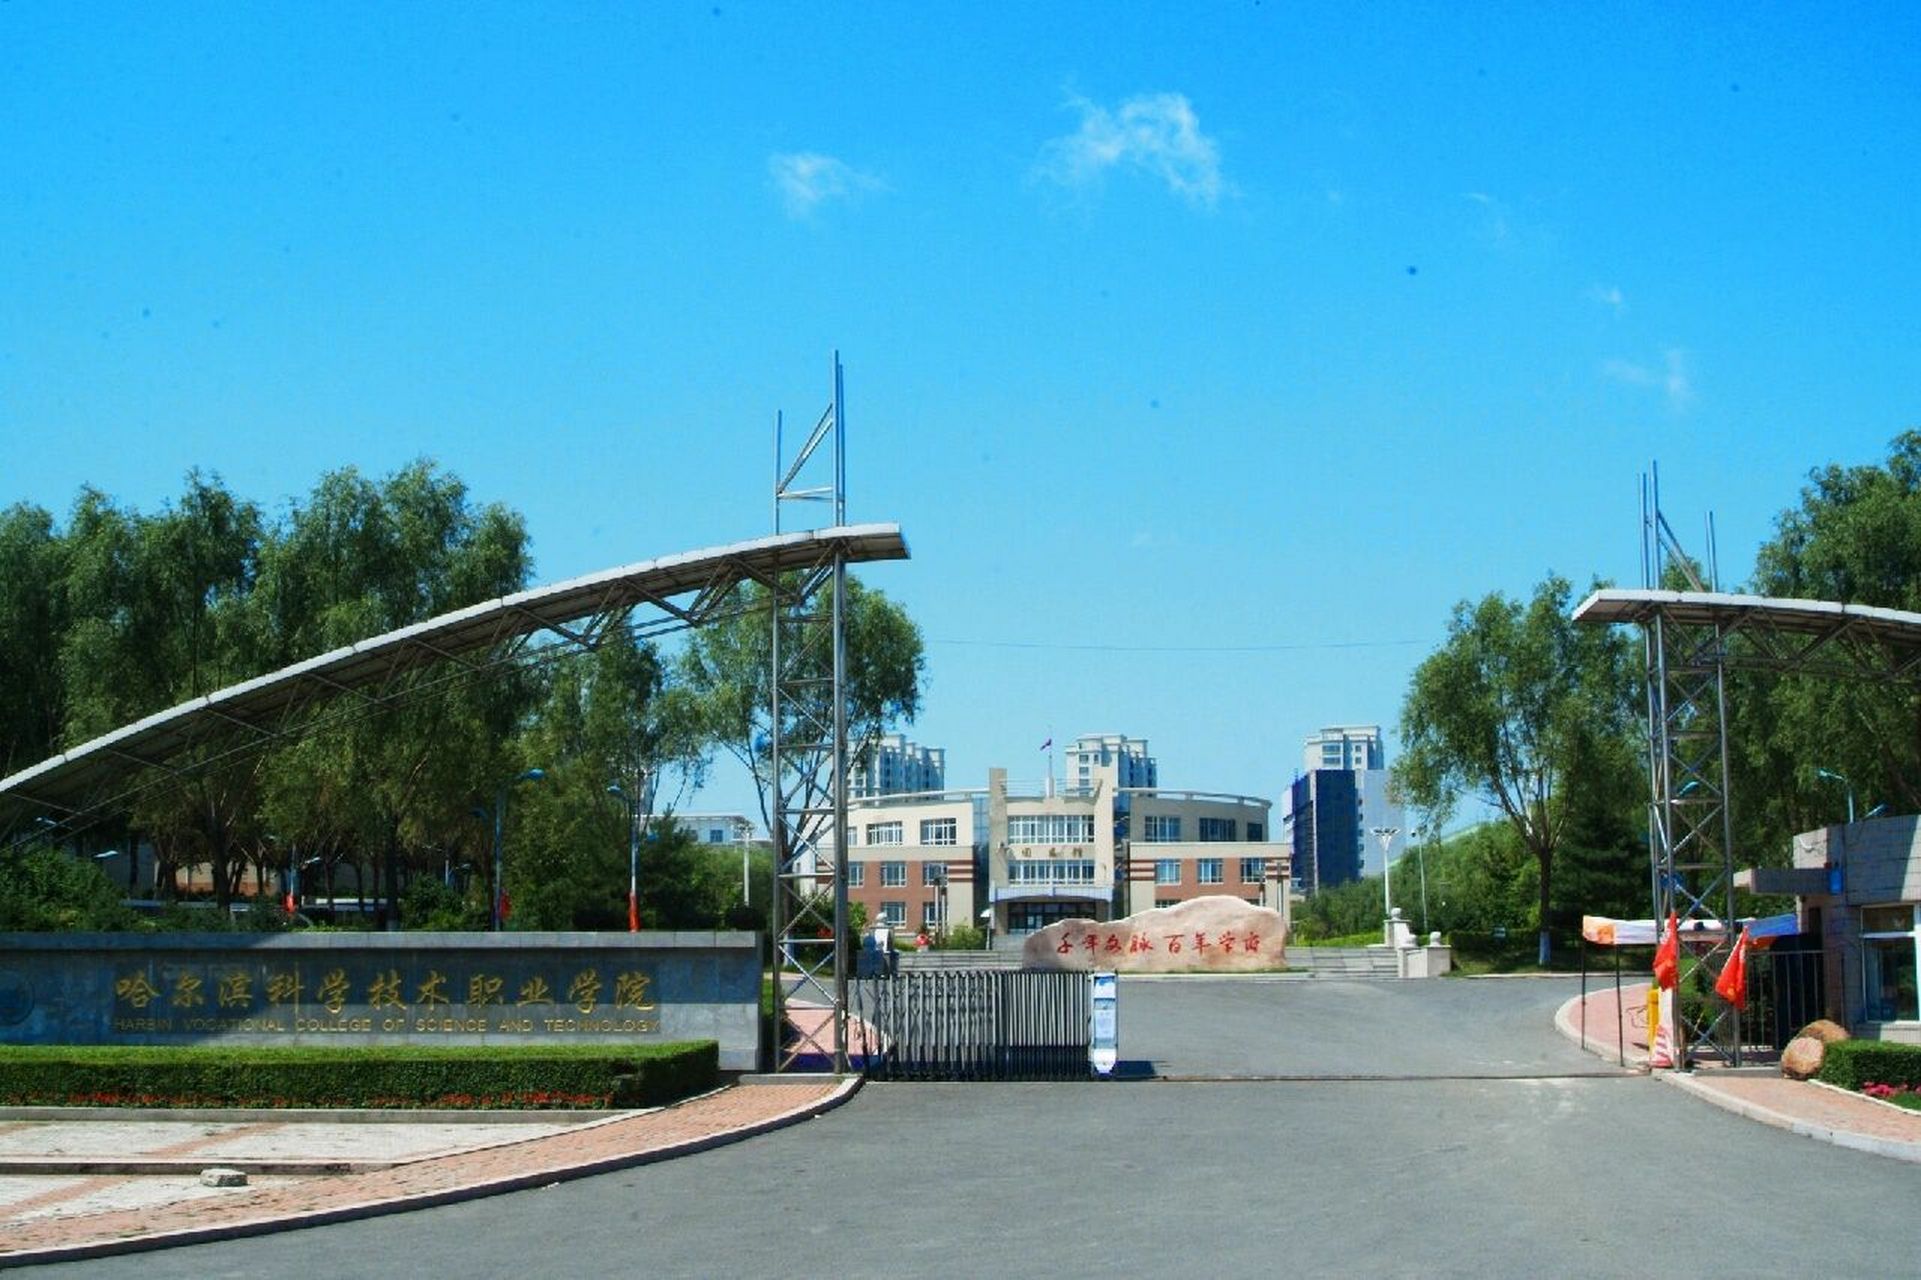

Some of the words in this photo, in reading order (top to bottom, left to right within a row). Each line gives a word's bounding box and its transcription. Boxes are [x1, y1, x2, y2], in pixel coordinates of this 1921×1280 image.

[115, 969, 655, 1014] 哈尔滨科学技术职业学院
[184, 1018, 285, 1032] VOCATIONAL
[297, 1018, 372, 1033] COLLEGE
[383, 1018, 405, 1033] OF
[415, 1018, 488, 1033] SCIENCE
[499, 1018, 534, 1033] AND
[544, 1018, 660, 1033] TECHNOLOGY
